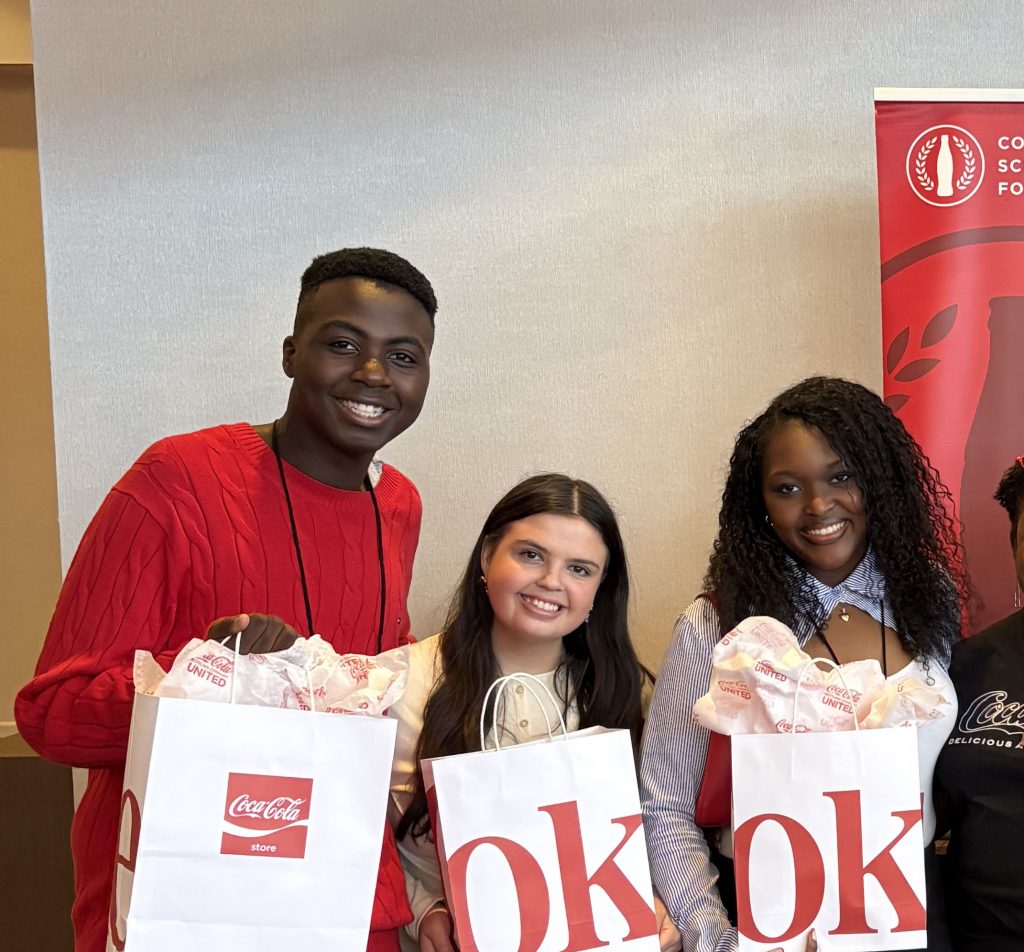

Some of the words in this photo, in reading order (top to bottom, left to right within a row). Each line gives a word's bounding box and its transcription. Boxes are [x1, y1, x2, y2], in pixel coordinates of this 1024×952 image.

[187, 662, 227, 687] UNITED
[755, 663, 787, 682] UNITED
[720, 686, 752, 700] UNITED
[948, 737, 1012, 748] DELICIOUS
[228, 794, 307, 820] Coca-Cola
[251, 843, 277, 852] store
[733, 790, 927, 944] ok
